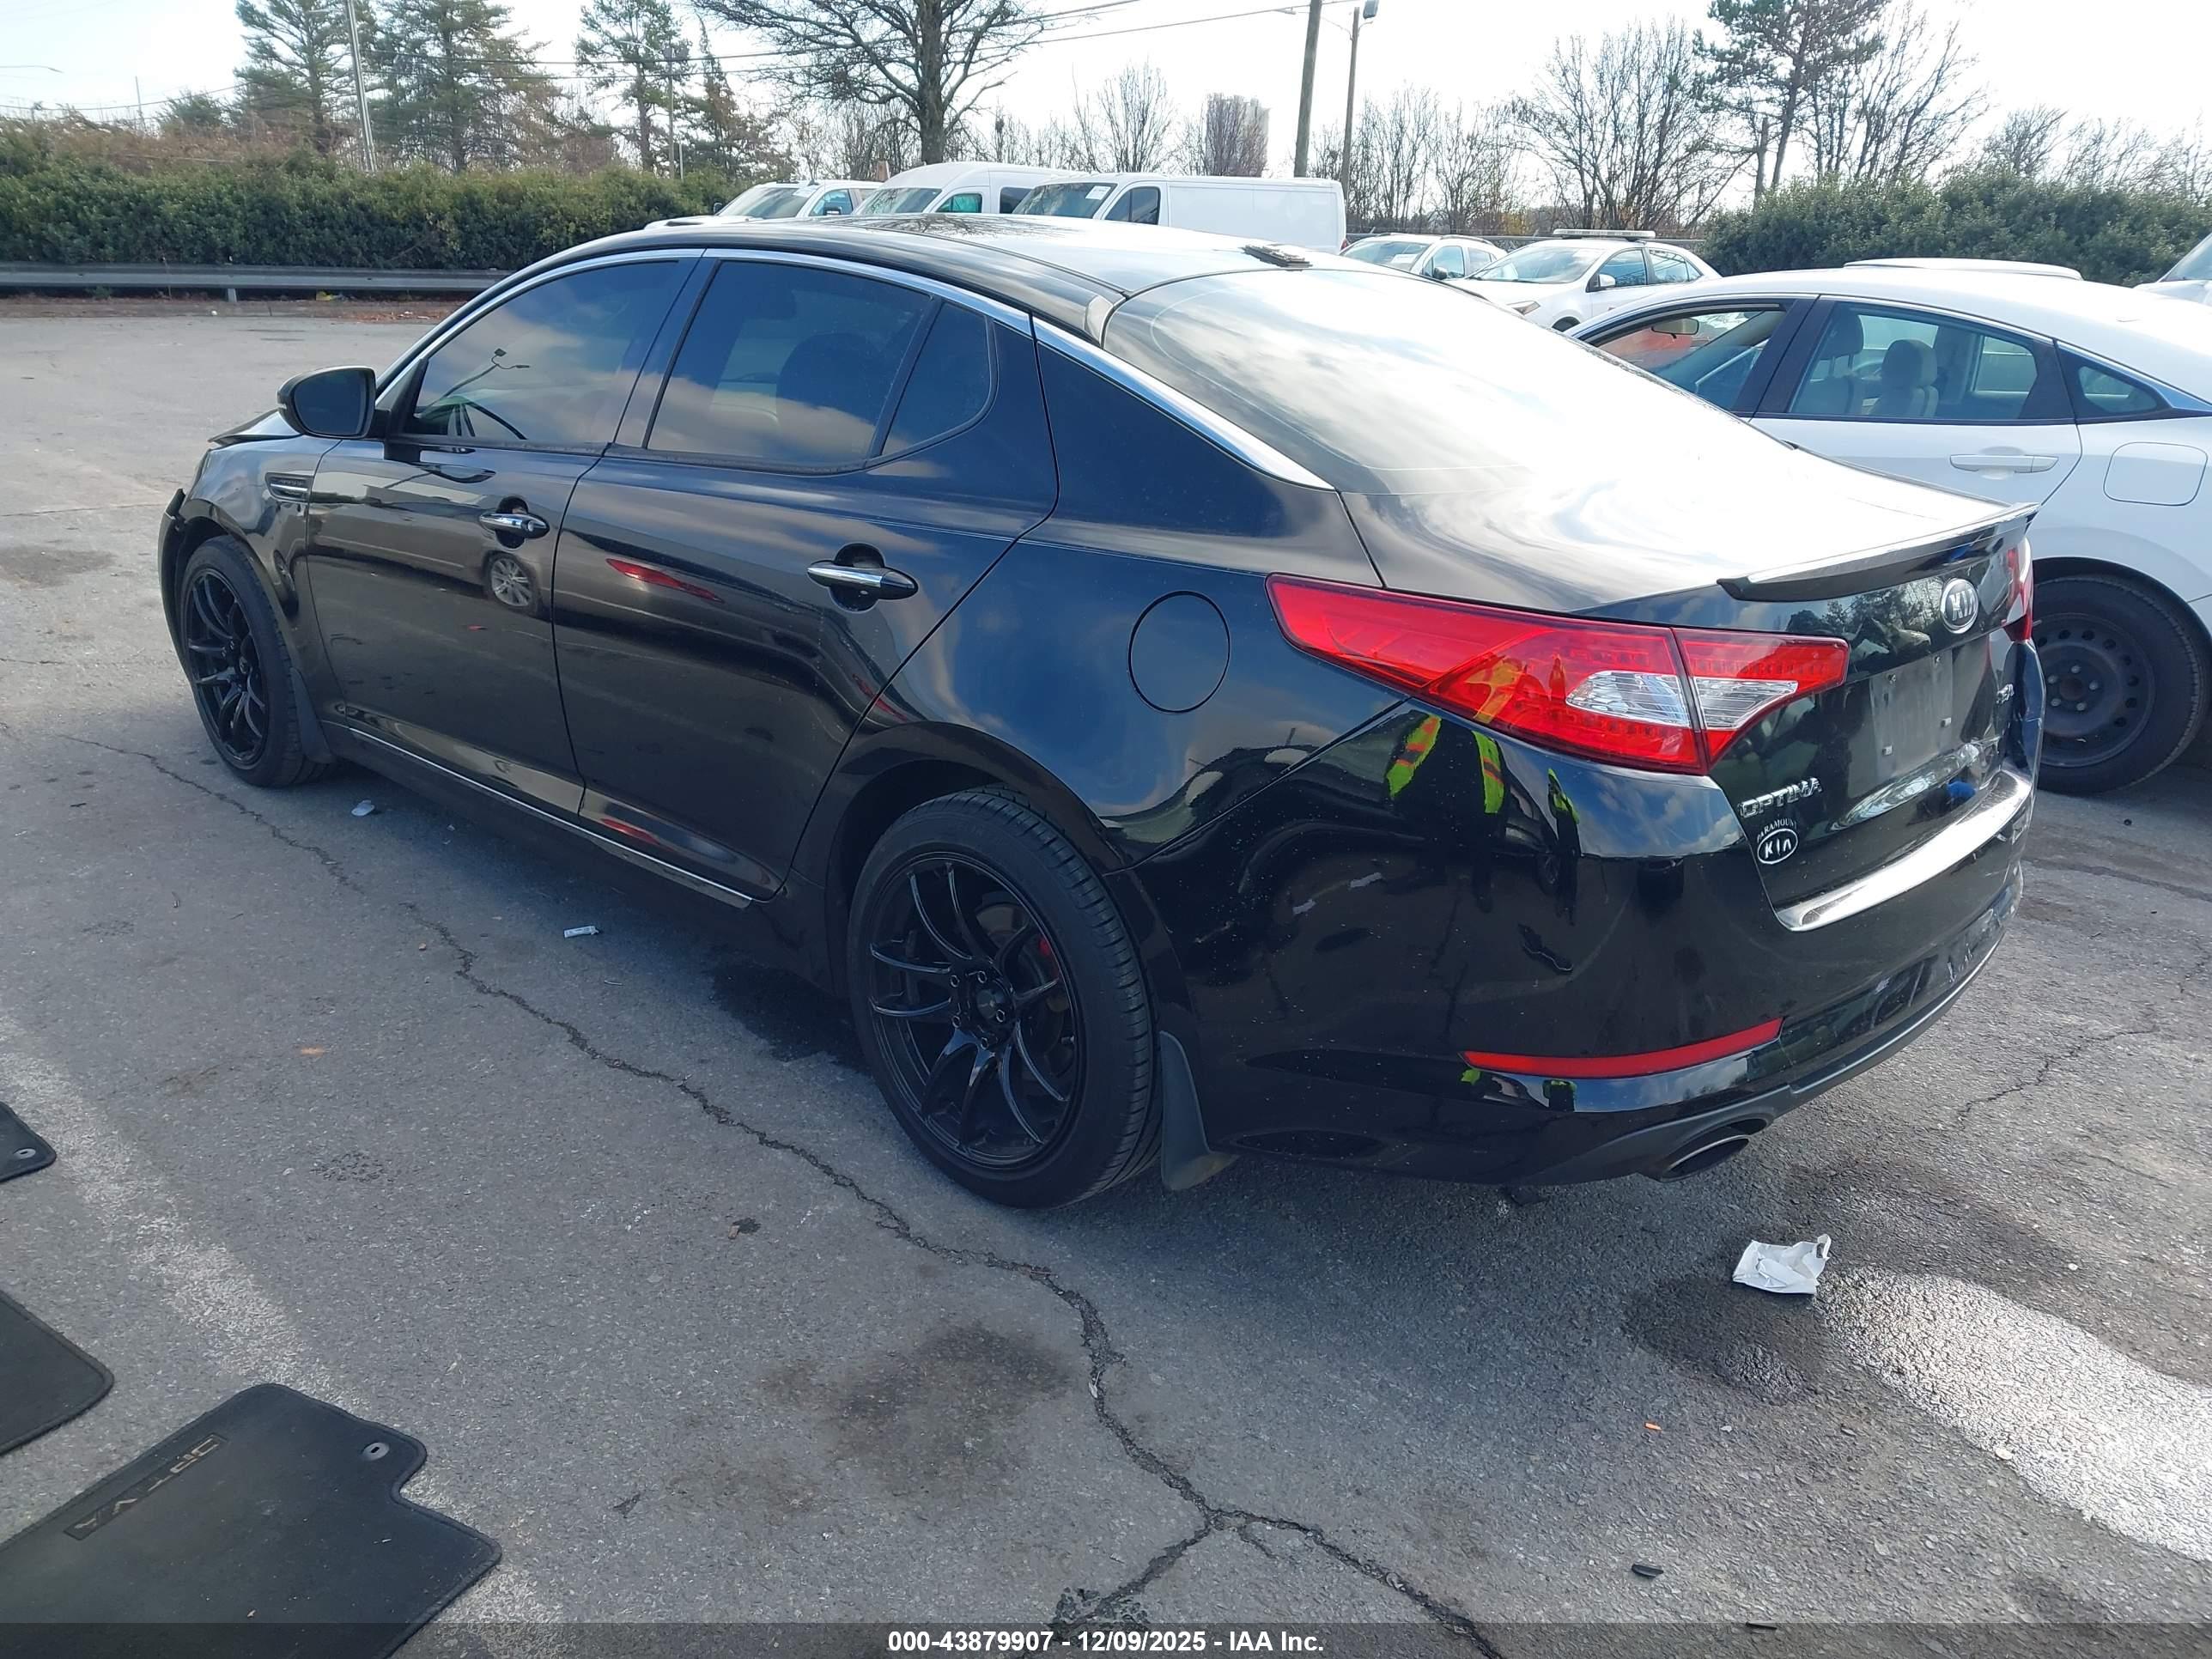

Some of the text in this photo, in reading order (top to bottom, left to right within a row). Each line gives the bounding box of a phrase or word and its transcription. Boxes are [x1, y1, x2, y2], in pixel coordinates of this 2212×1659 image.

[1948, 588, 1974, 621] KIA
[1737, 777, 1822, 818] OPTIMA
[1765, 838, 1792, 859] KIA
